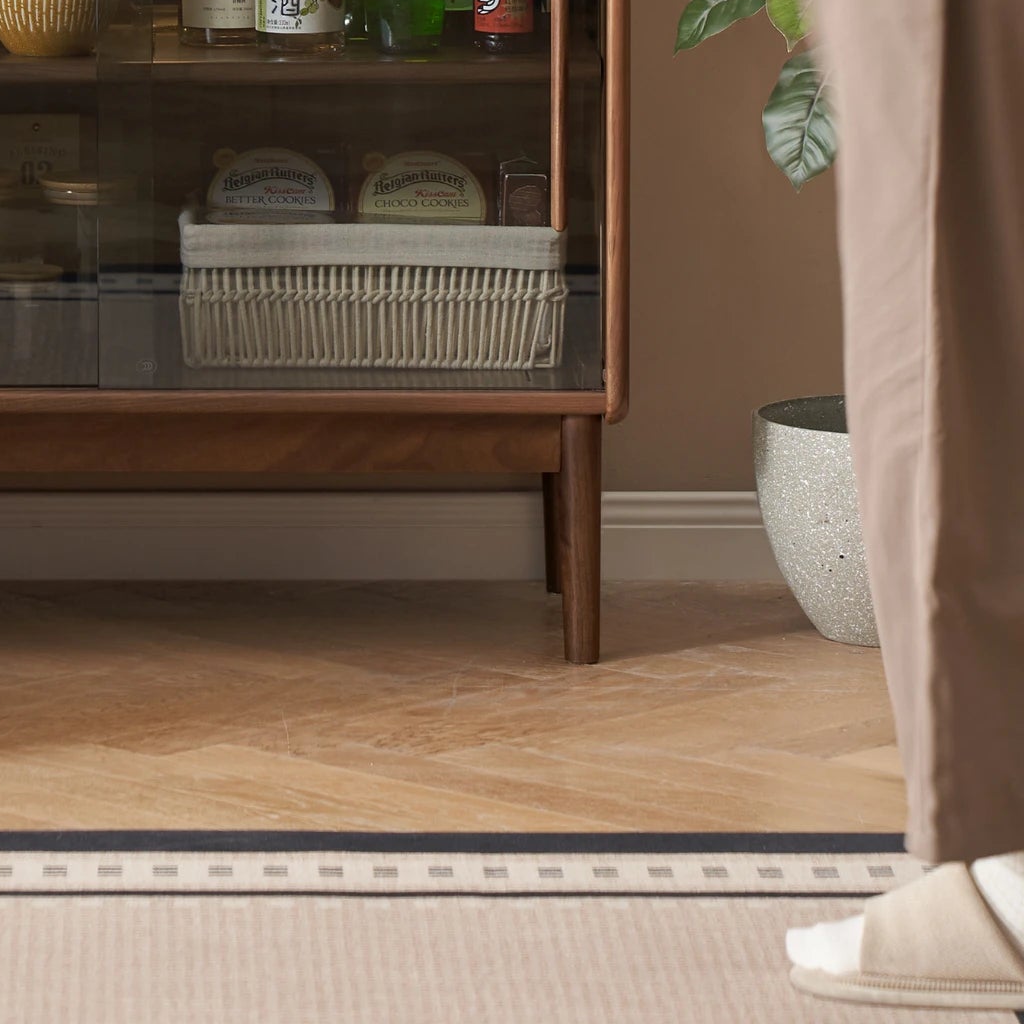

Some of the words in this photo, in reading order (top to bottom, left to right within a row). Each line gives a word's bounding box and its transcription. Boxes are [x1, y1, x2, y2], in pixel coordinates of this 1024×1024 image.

[268, 195, 316, 205] COOKIES
[374, 198, 418, 208] CHOCO
[421, 198, 469, 208] COOKIES
